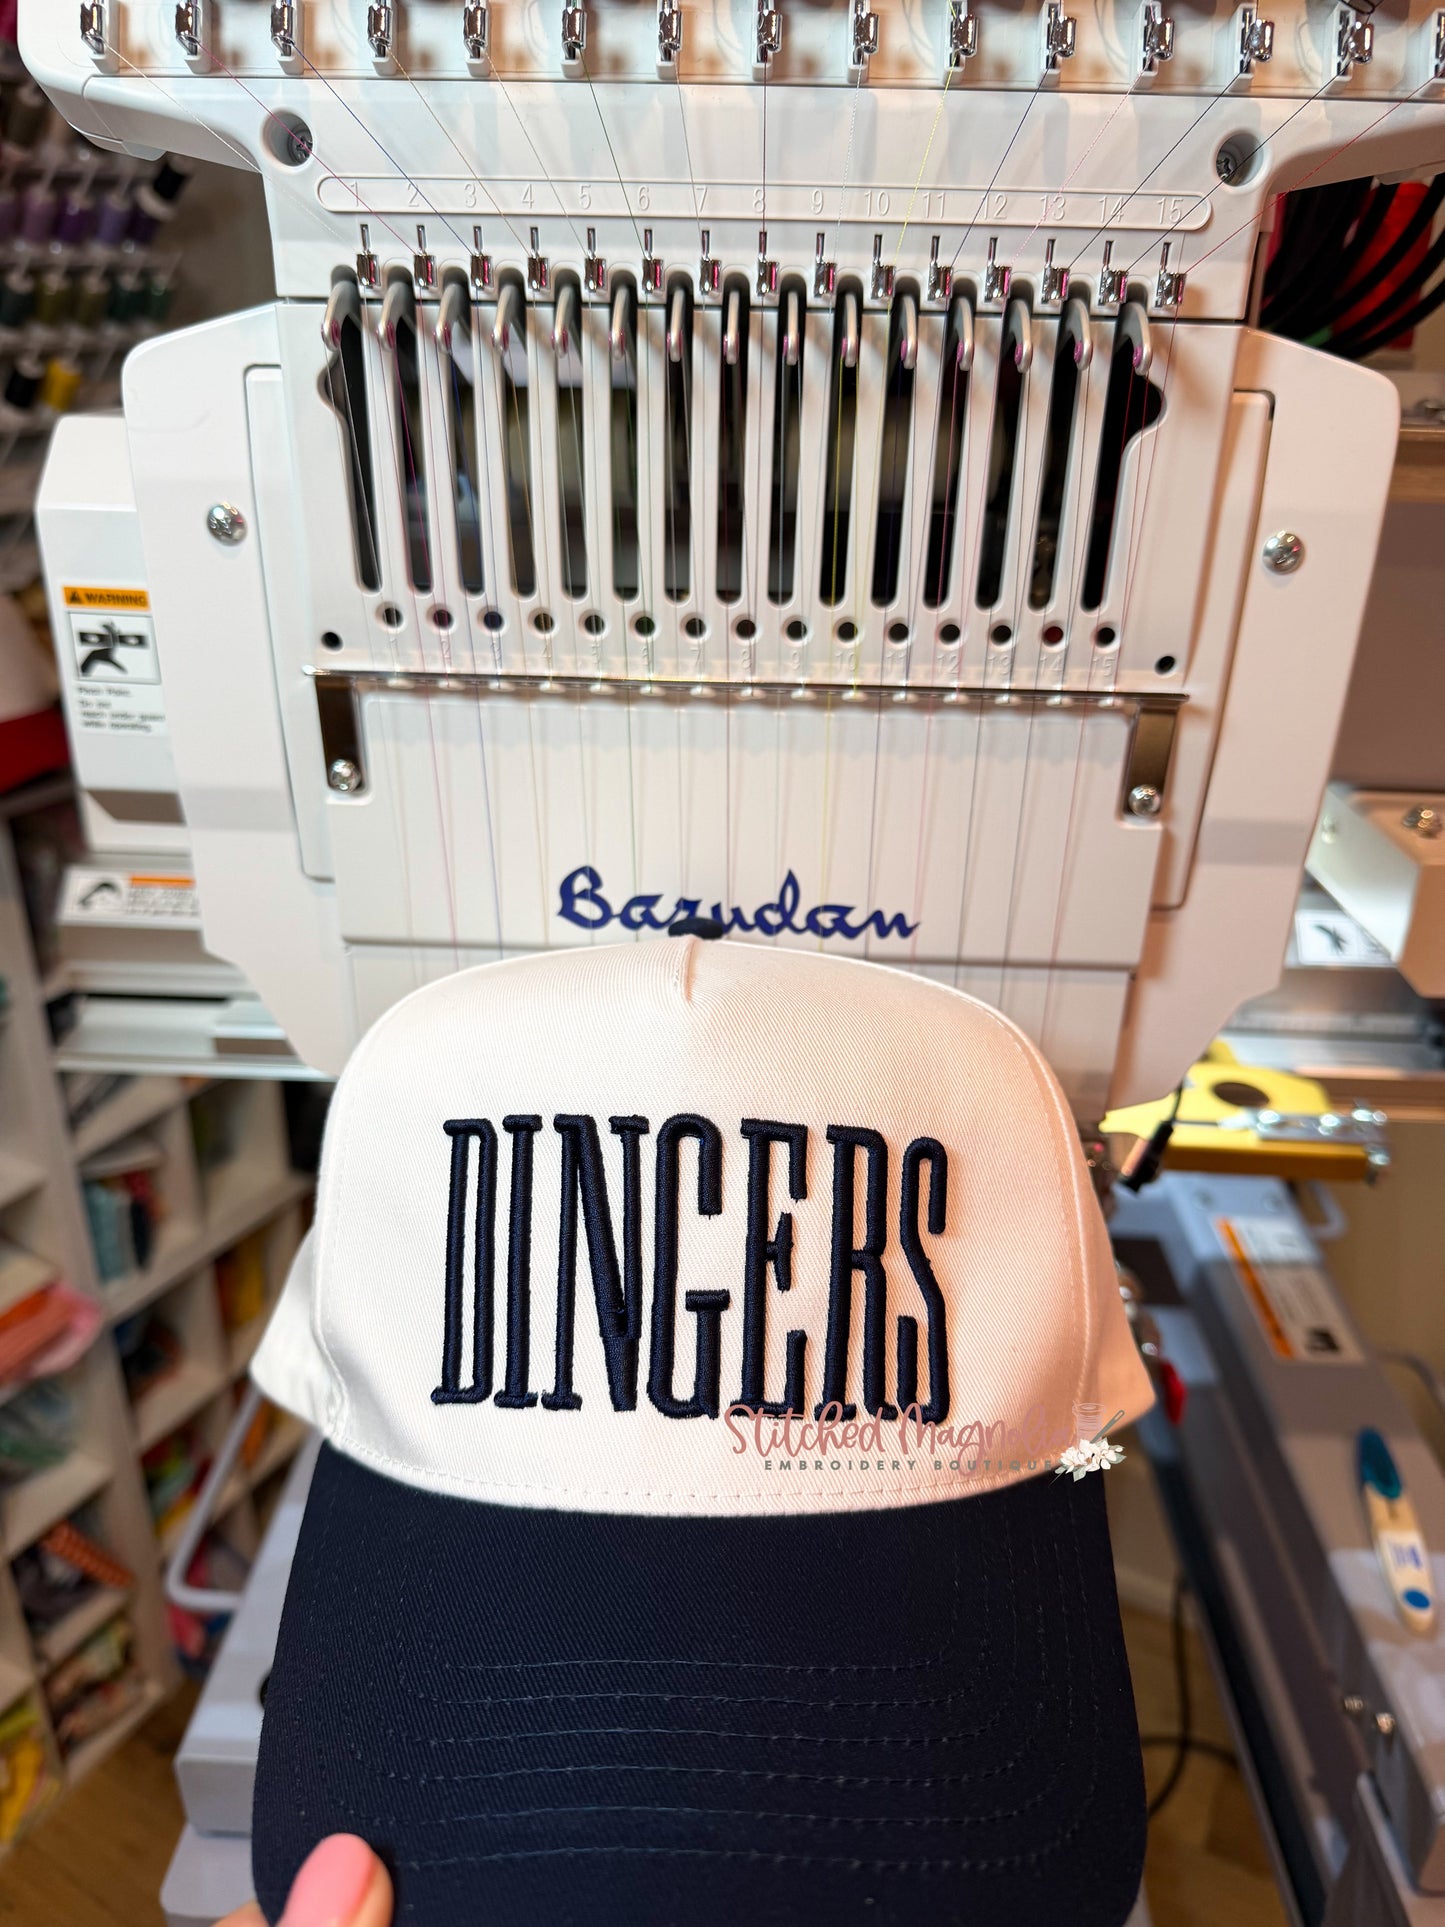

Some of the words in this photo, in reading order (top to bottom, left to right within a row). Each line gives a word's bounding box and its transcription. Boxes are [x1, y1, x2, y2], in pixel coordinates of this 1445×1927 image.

[350, 181, 360, 207] 1
[407, 183, 420, 207] 2
[463, 183, 477, 208] 3
[521, 184, 535, 209] 4
[578, 184, 592, 210] 5
[637, 186, 650, 211] 6
[695, 186, 708, 212] 7
[752, 188, 765, 214] 8
[811, 189, 824, 215] 9
[864, 190, 891, 217] 10
[922, 191, 947, 219] 11
[981, 194, 1008, 220] 12
[1039, 194, 1066, 221] 13
[1099, 195, 1125, 223] 14
[1157, 197, 1184, 224] 15
[431, 1113, 950, 1426] DINGERS
